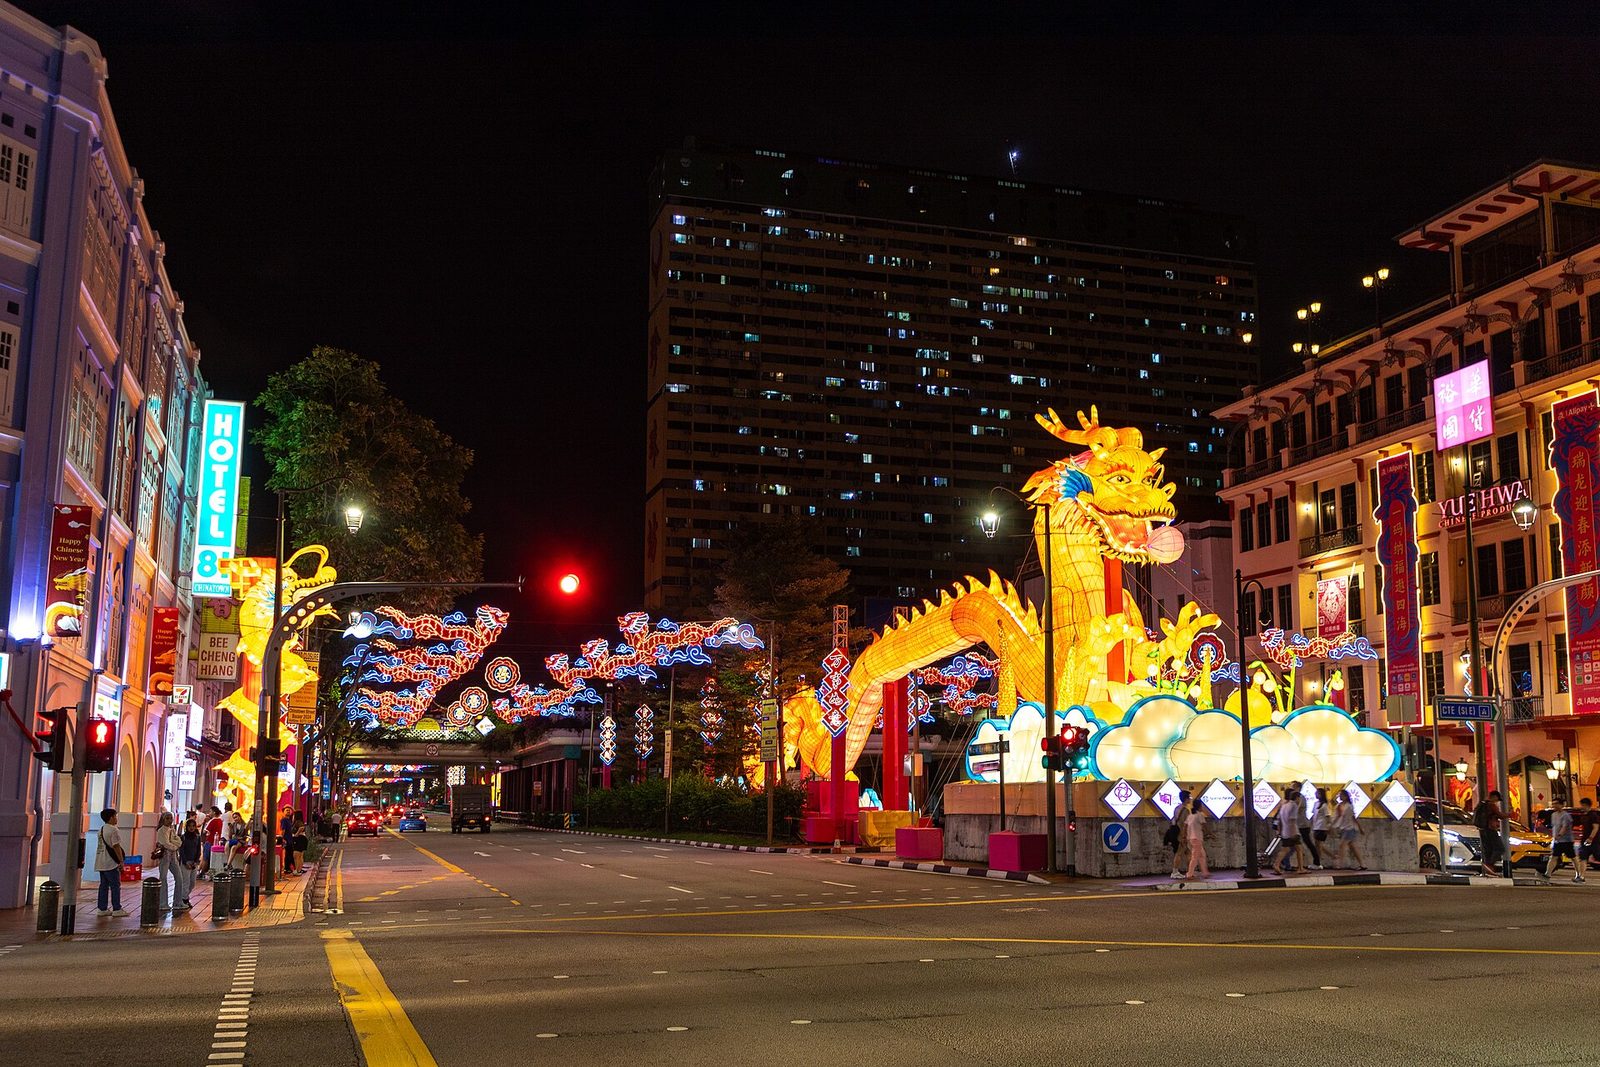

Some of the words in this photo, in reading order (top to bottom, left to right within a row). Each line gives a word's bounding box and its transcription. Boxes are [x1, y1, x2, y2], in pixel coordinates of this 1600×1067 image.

[208, 413, 234, 539] HOTEL
[1480, 481, 1528, 509] HWA
[1438, 512, 1477, 529] CHINEE
[59, 537, 82, 545] Happy
[56, 546, 84, 554] Chinese
[193, 583, 230, 593] CHINATOWN
[209, 637, 229, 648] BEE
[201, 650, 236, 662] CHENG
[200, 664, 234, 676] HIANG
[1442, 705, 1455, 715] CTE
